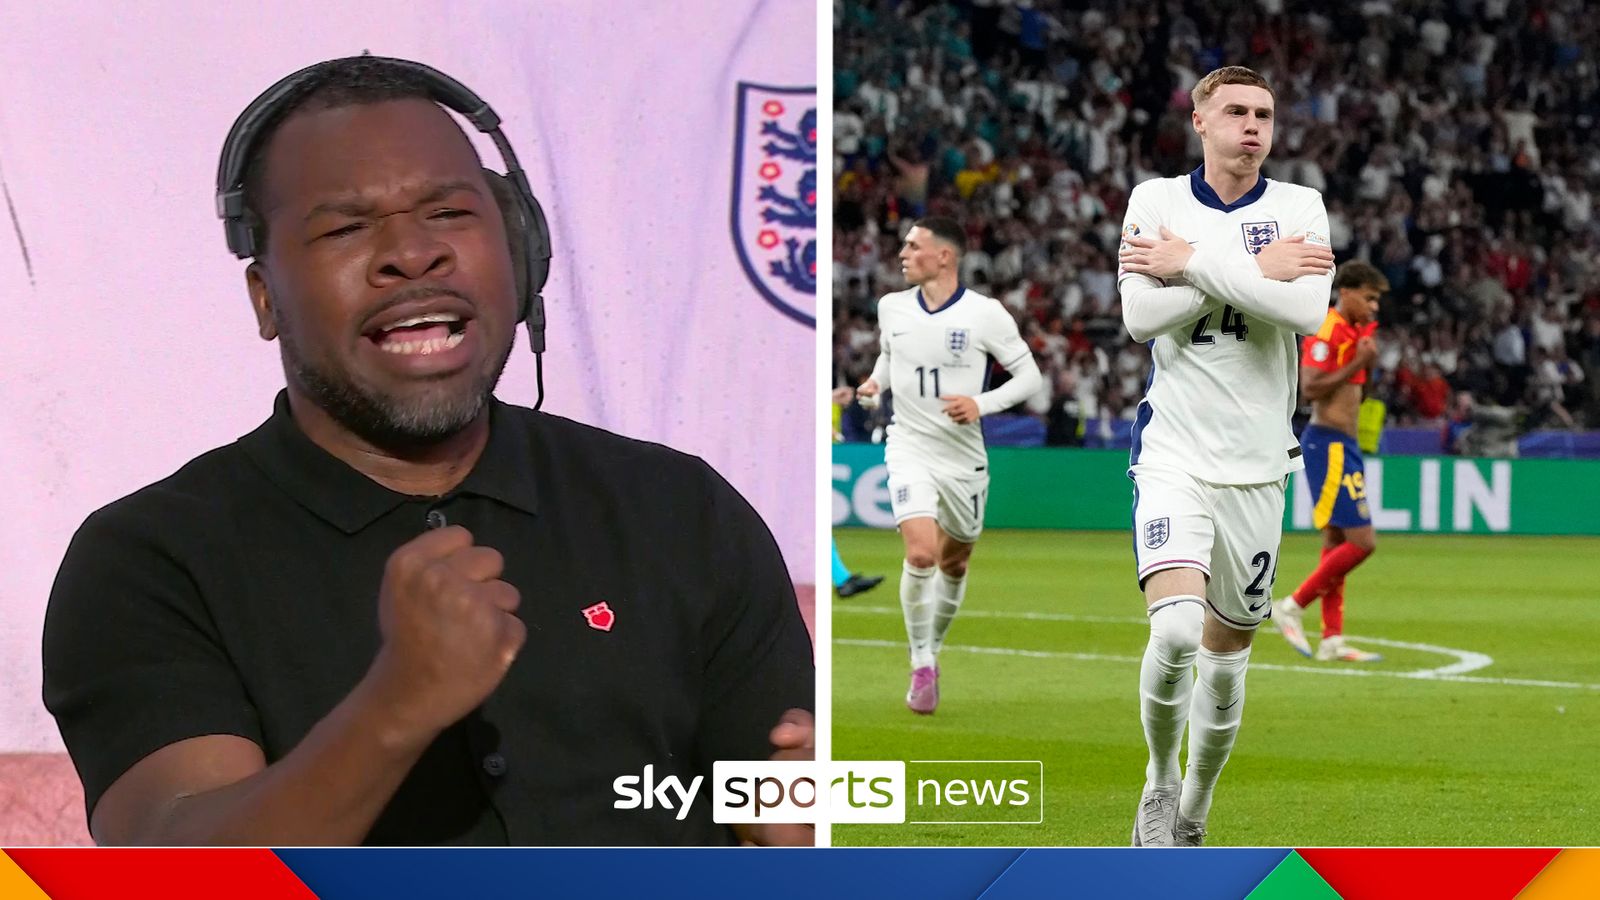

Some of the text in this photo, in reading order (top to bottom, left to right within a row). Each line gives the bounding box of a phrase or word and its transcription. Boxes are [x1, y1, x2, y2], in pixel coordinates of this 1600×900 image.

[1191, 304, 1249, 346] 24
[915, 366, 941, 399] 11
[1244, 546, 1279, 599] 2
